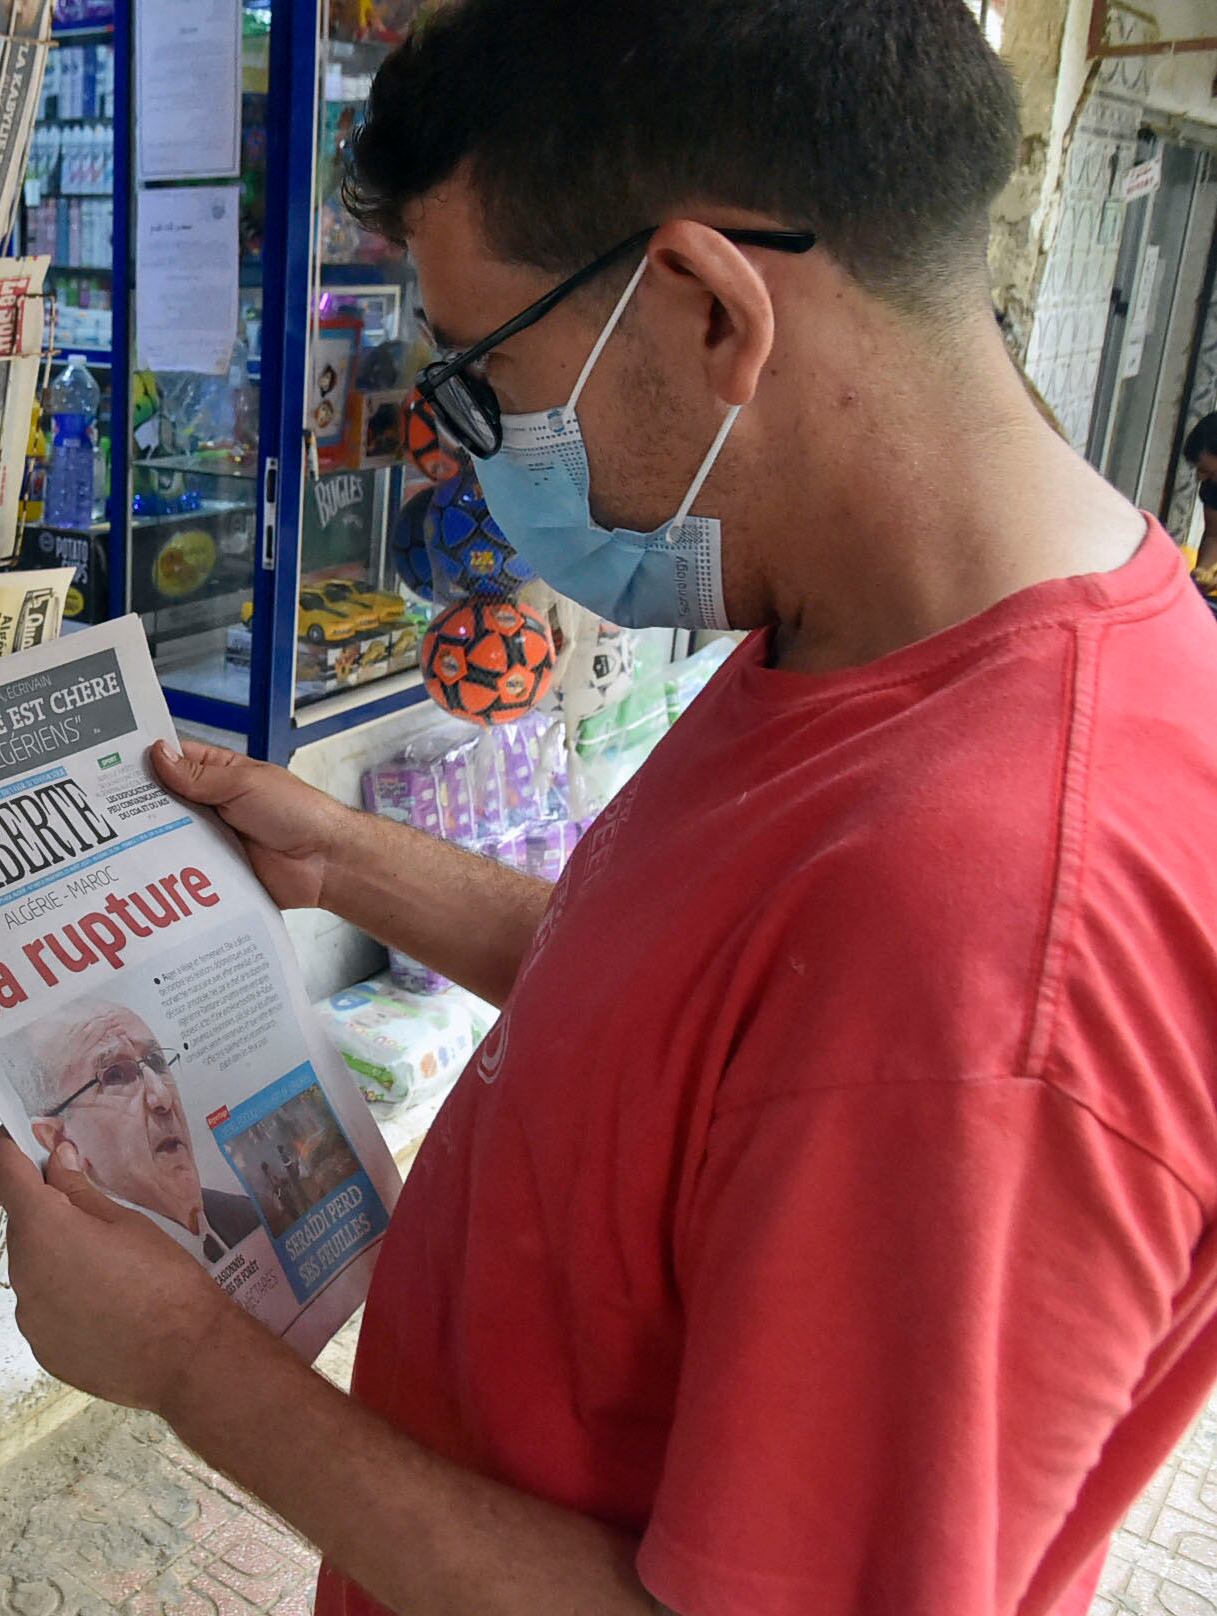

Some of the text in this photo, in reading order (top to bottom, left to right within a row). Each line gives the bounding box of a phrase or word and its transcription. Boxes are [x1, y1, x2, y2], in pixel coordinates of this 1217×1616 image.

[6, 696, 49, 730] EST
[45, 665, 121, 716] CHÈRE
[107, 803, 122, 815] PEU
[118, 811, 129, 821] DU
[0, 864, 120, 930] ALGÉRIE MAROC
[17, 851, 225, 1001] rupture
[283, 1183, 364, 1260] SERAÏDI PERD
[298, 1214, 373, 1286] SES FEUILLES
[239, 1258, 260, 1283] FORÊT
